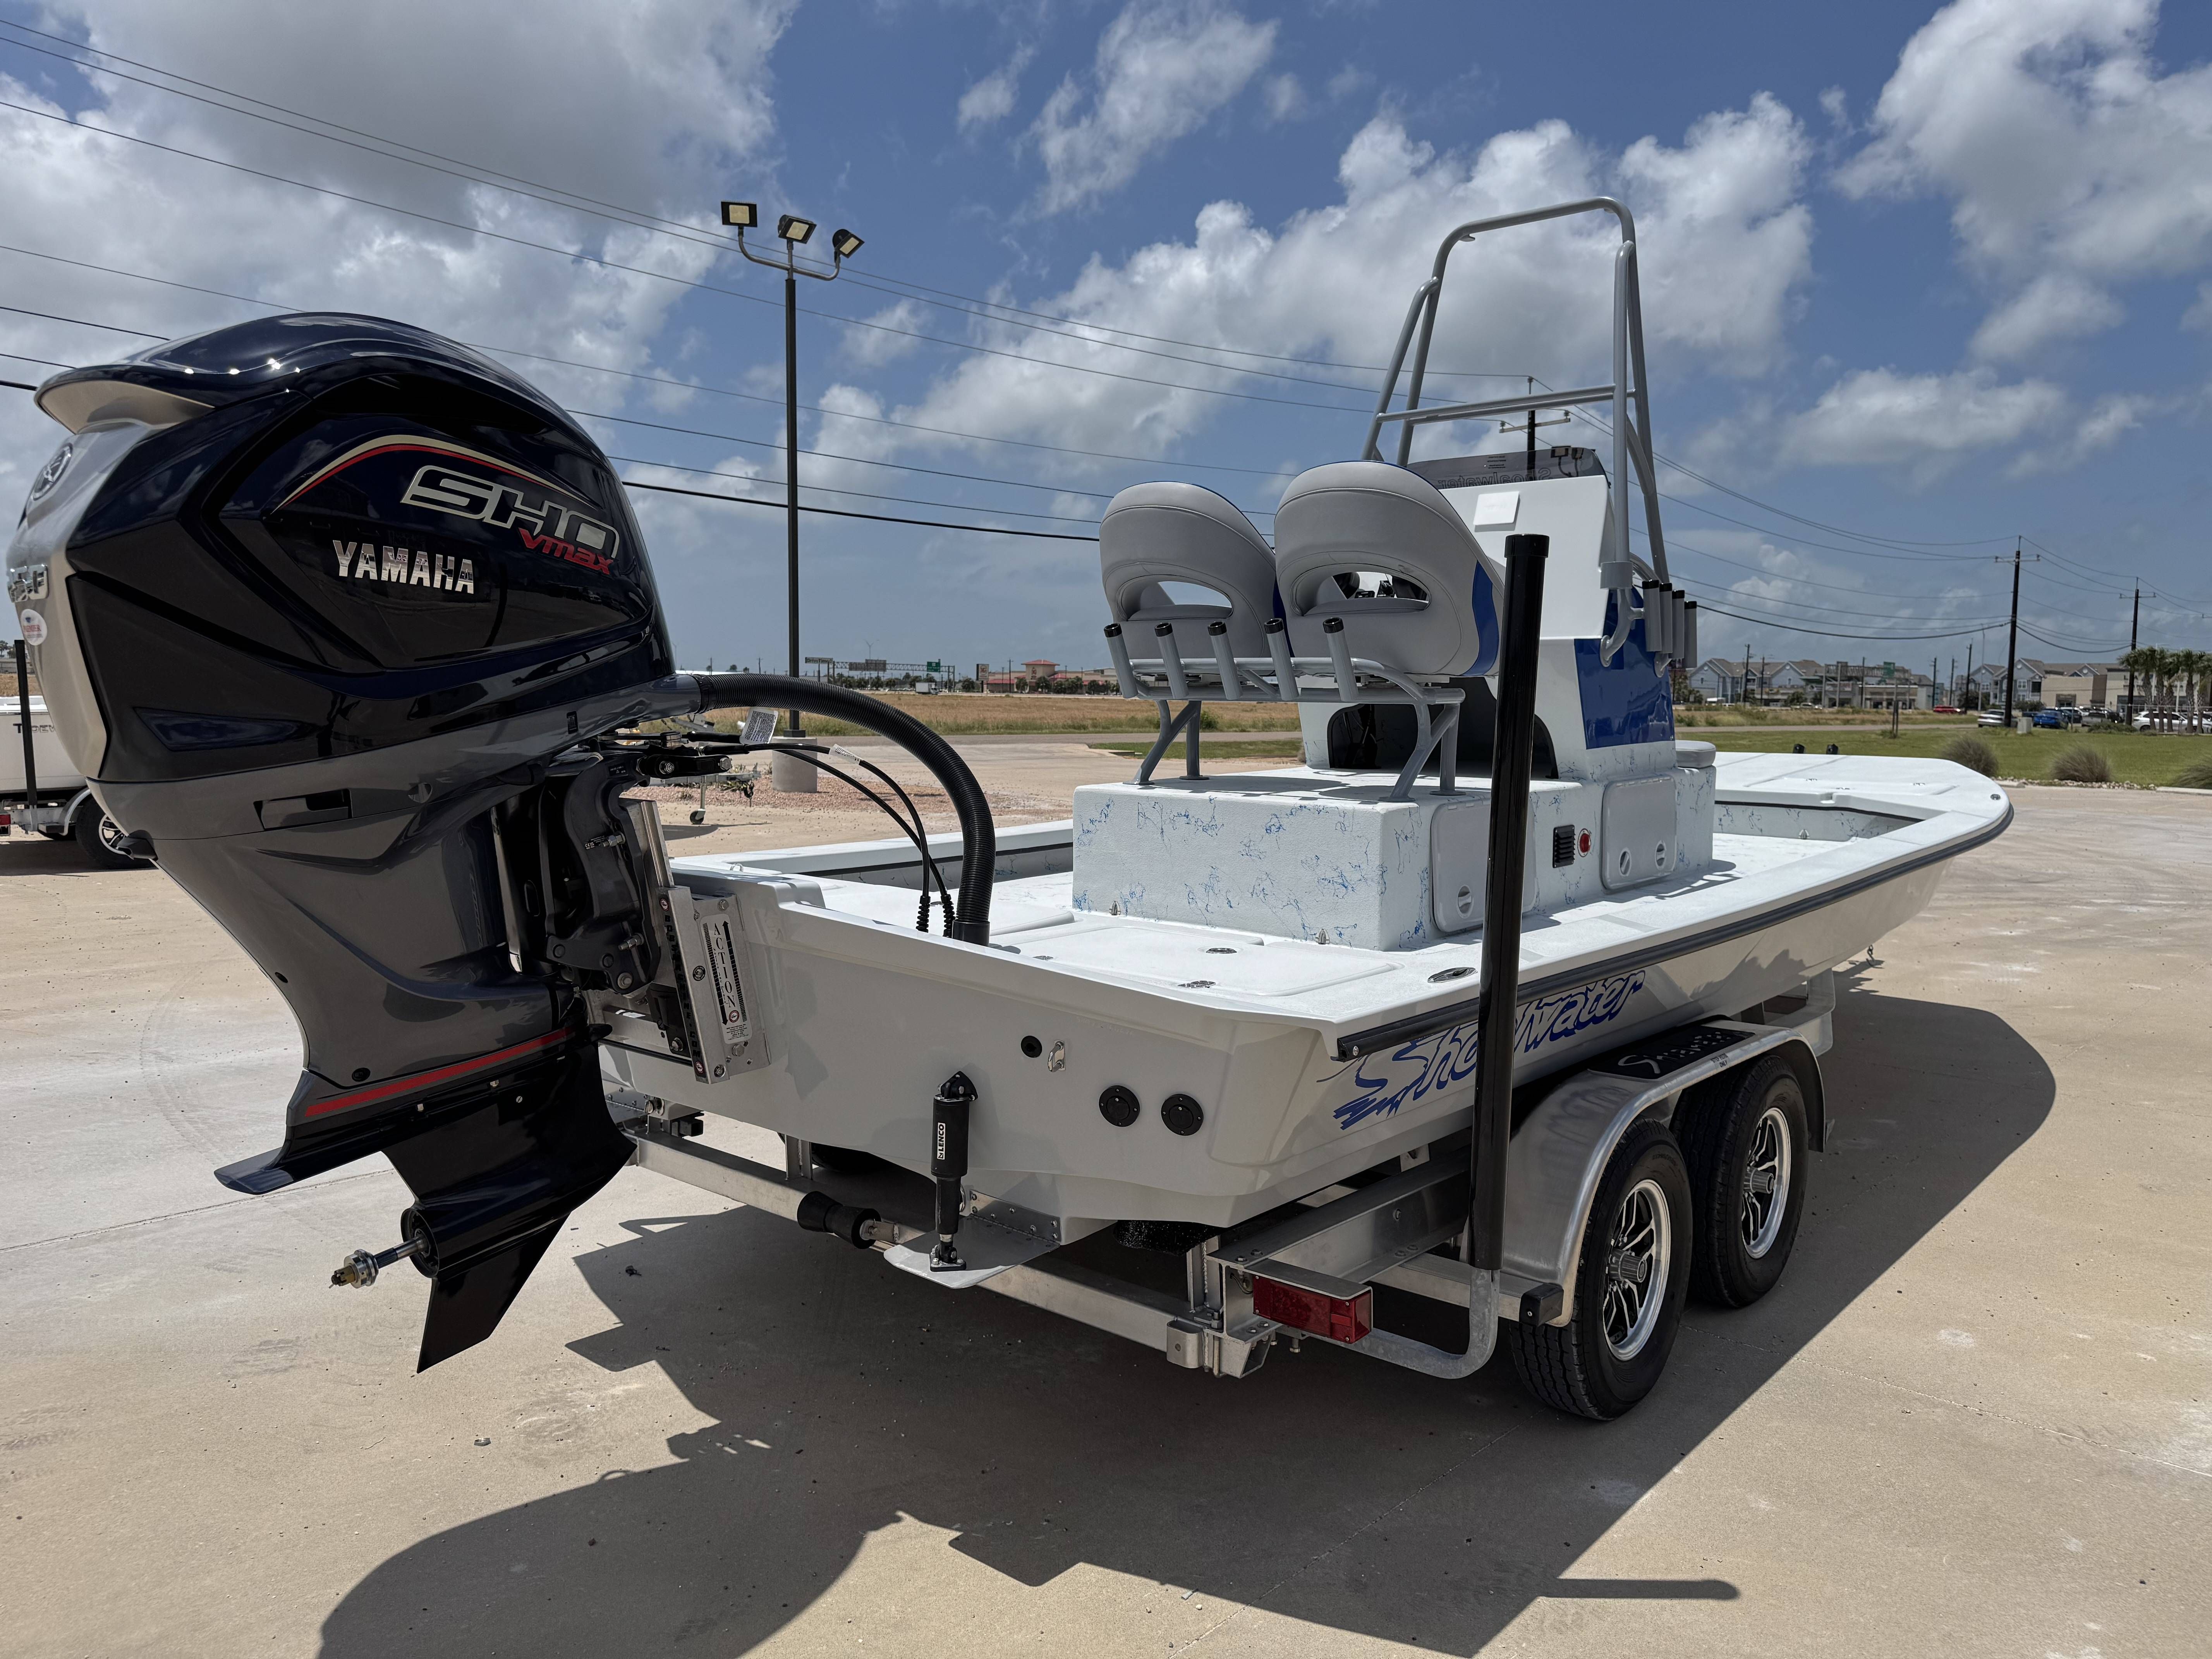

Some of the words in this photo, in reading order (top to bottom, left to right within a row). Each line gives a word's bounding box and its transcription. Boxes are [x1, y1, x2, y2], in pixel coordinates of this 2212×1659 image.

[400, 465, 620, 558] SHO
[333, 540, 474, 594] YAMAHA
[714, 922, 736, 1008] ACTION
